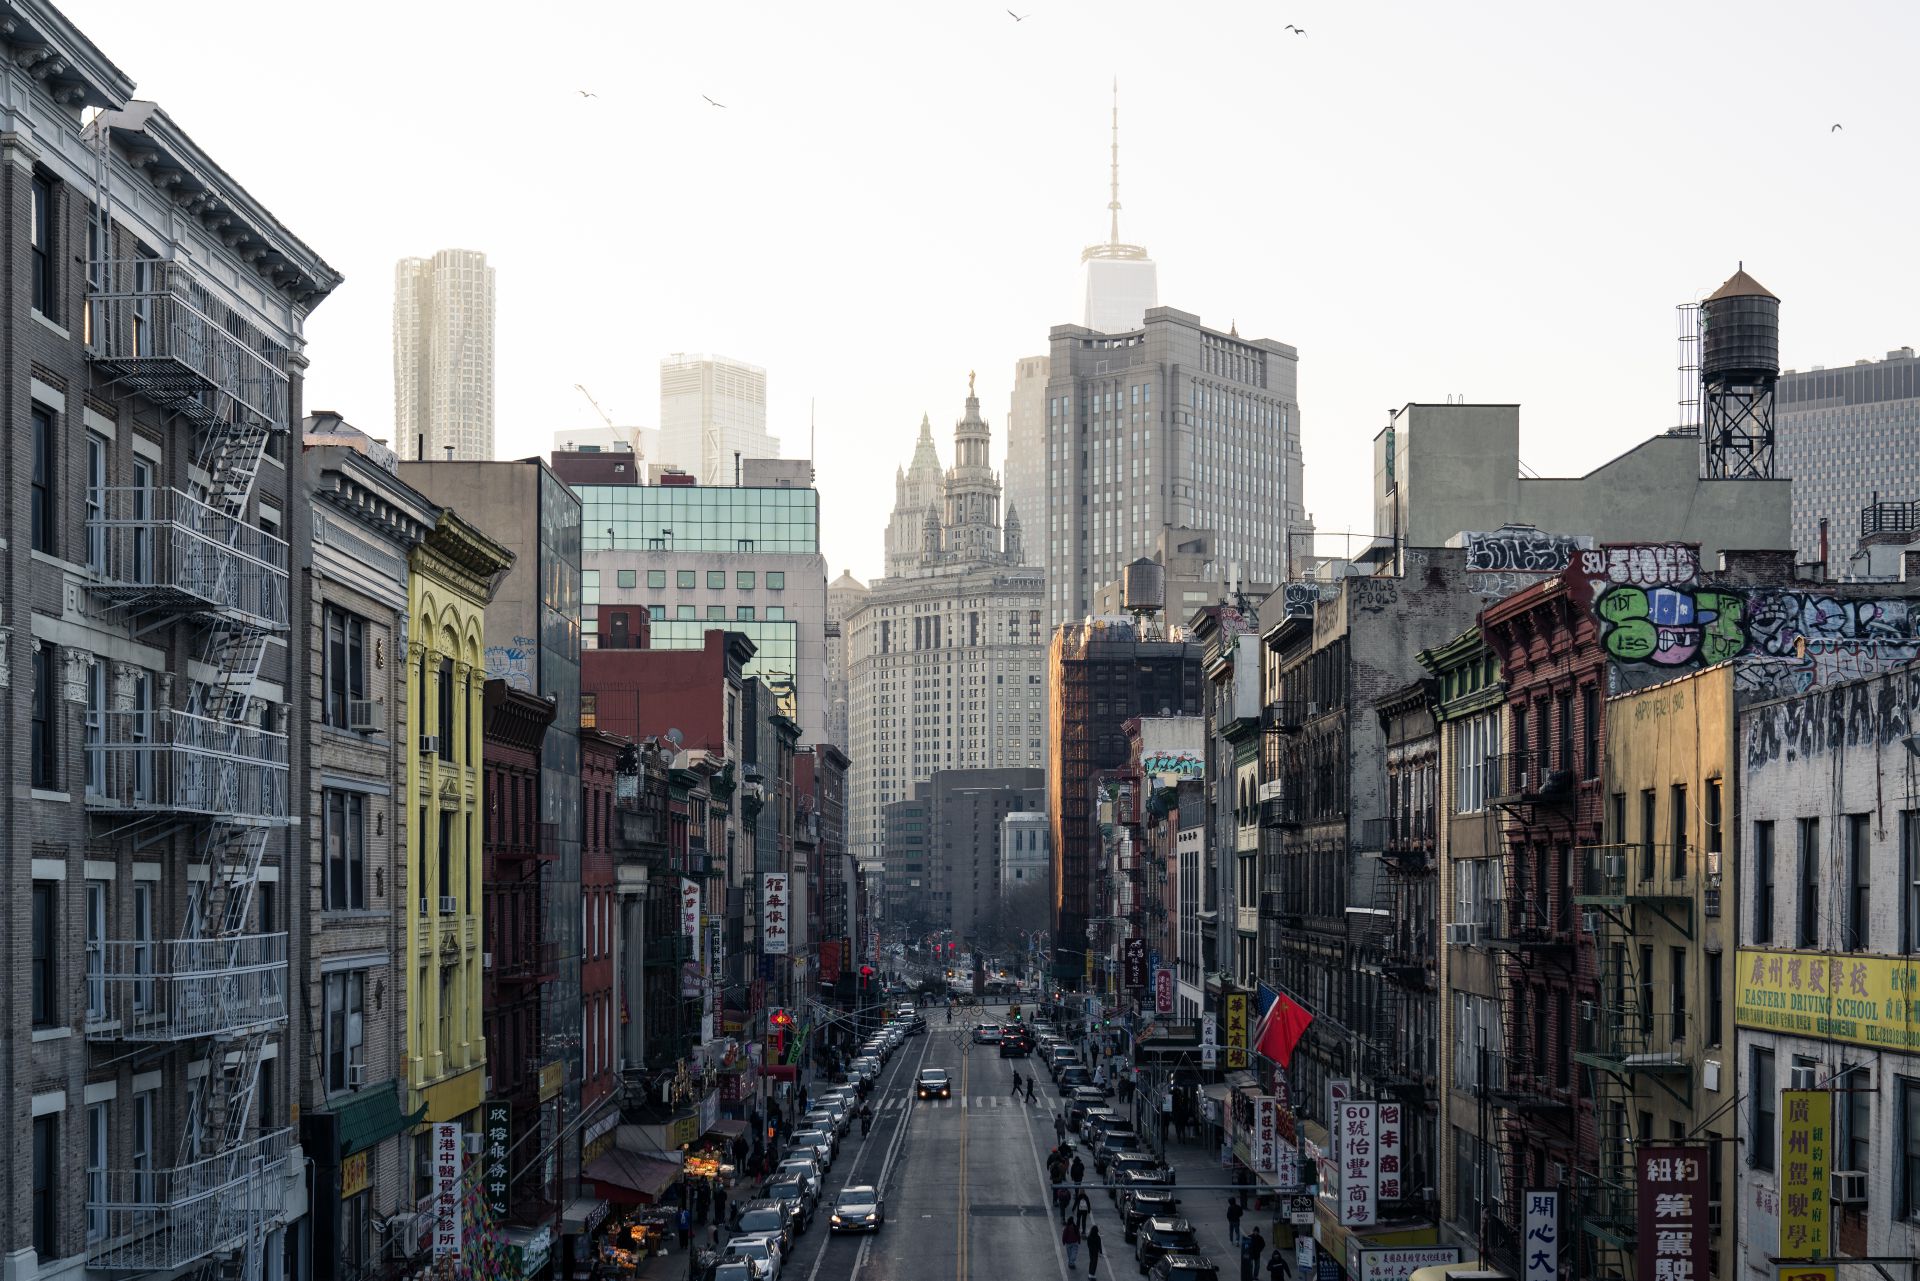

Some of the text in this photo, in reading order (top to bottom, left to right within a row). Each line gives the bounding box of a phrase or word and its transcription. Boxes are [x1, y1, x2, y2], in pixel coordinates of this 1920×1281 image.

[1359, 590, 1398, 604] FOOLS
[1745, 989, 1878, 1020] EASTERN DRIVING SCHOOL
[1751, 955, 1869, 997] 廣州駕駛學校
[1229, 997, 1246, 1066] 華美商場
[489, 1109, 508, 1214] 欣榕服務中心
[1260, 1102, 1273, 1170] 興旺旺商場
[1647, 1158, 1699, 1182] 紐約
[439, 1126, 455, 1245] 香港中醫骨傷科診所
[1529, 1196, 1555, 1281] 開心大
